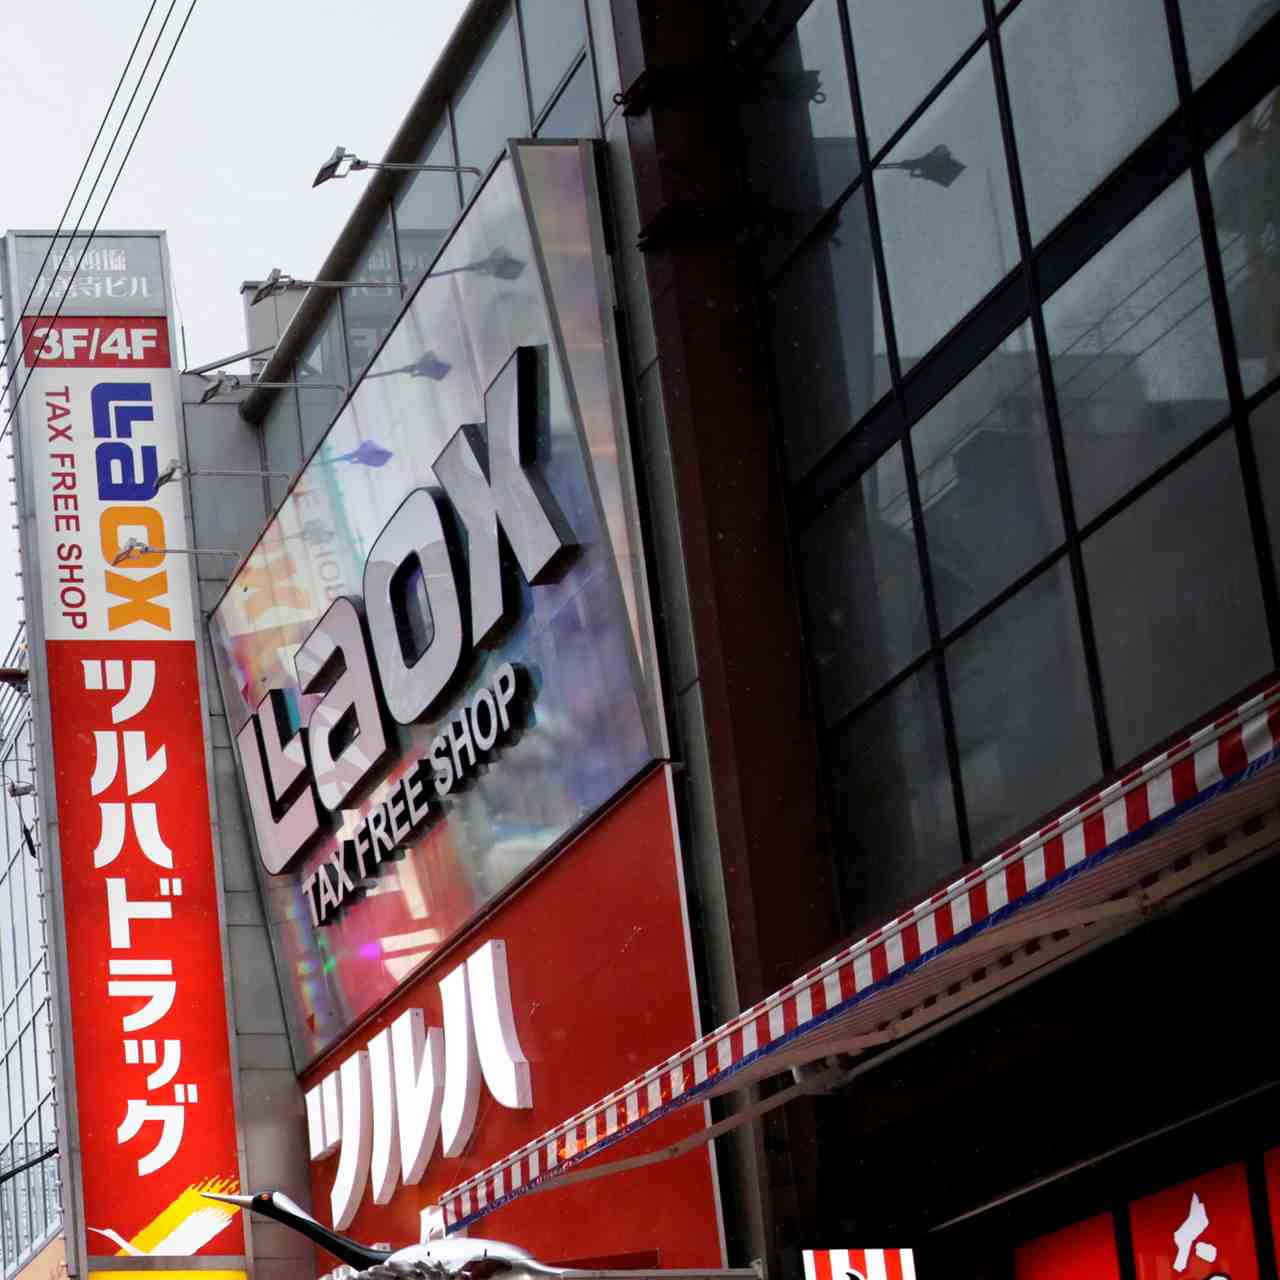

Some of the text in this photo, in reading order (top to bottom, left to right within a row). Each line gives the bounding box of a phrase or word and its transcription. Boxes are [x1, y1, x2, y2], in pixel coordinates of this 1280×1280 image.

[32, 327, 158, 360] 3F/4F
[44, 385, 88, 630] TAX FREE SHOP
[80, 659, 199, 1178] ツルハドラッグ
[300, 661, 519, 928] TAX FREE SHOP
[305, 939, 533, 1231] ツルハ
